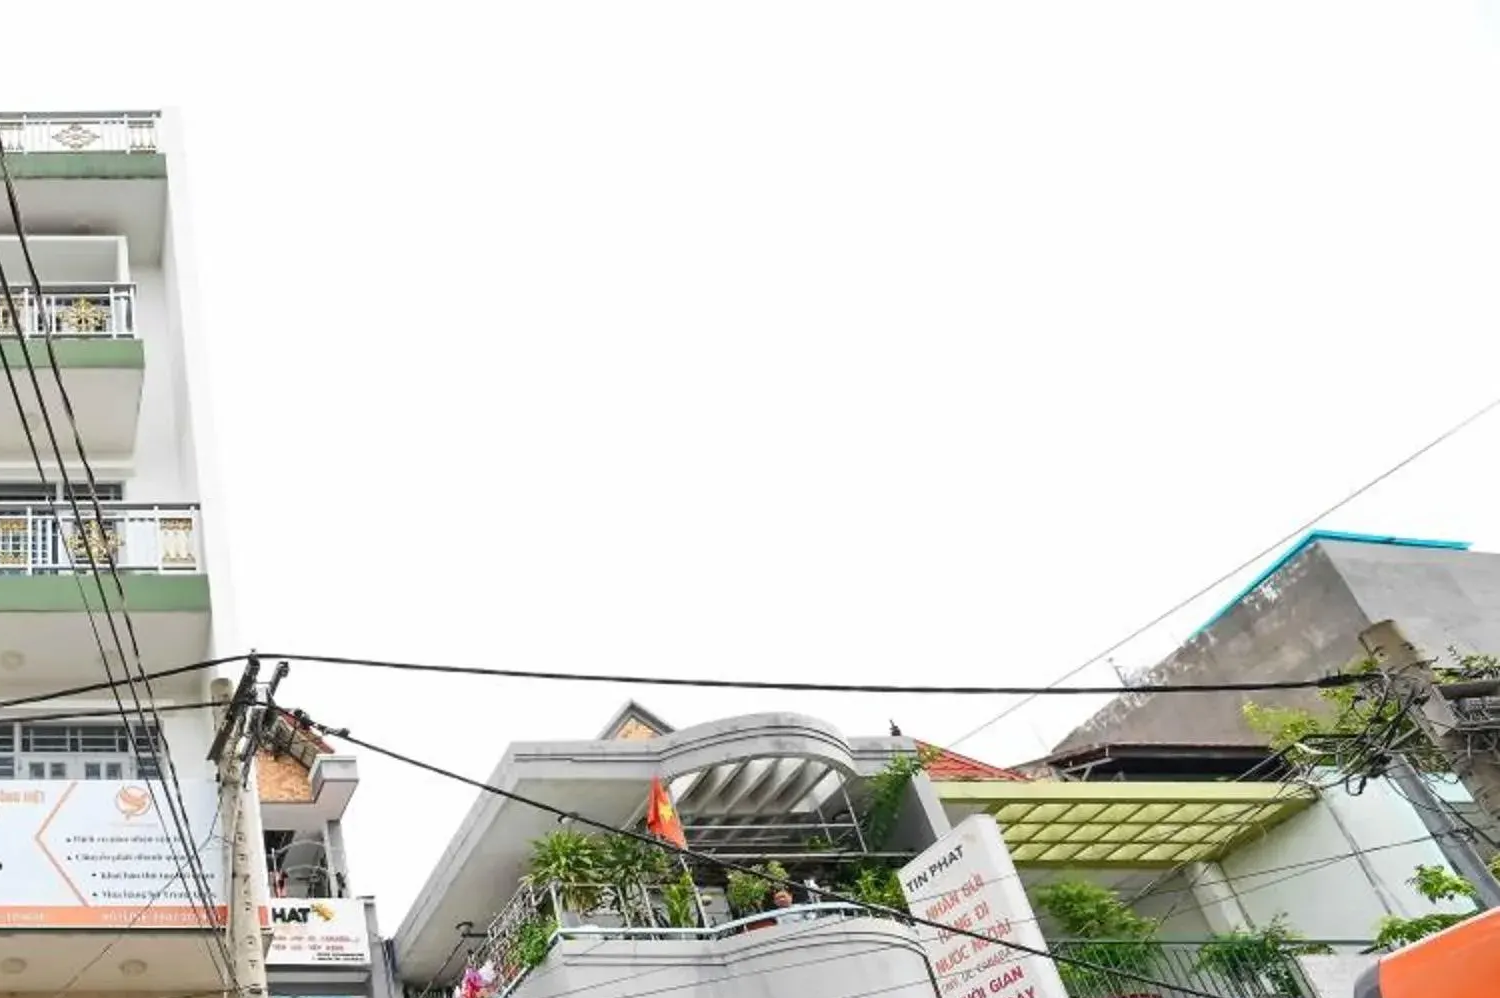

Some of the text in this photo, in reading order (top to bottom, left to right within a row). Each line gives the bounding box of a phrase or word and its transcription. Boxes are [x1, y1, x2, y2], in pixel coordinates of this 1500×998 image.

[905, 844, 963, 893] TIN PHAT
[271, 907, 311, 923] HAT
[989, 965, 1025, 993] GIAN
